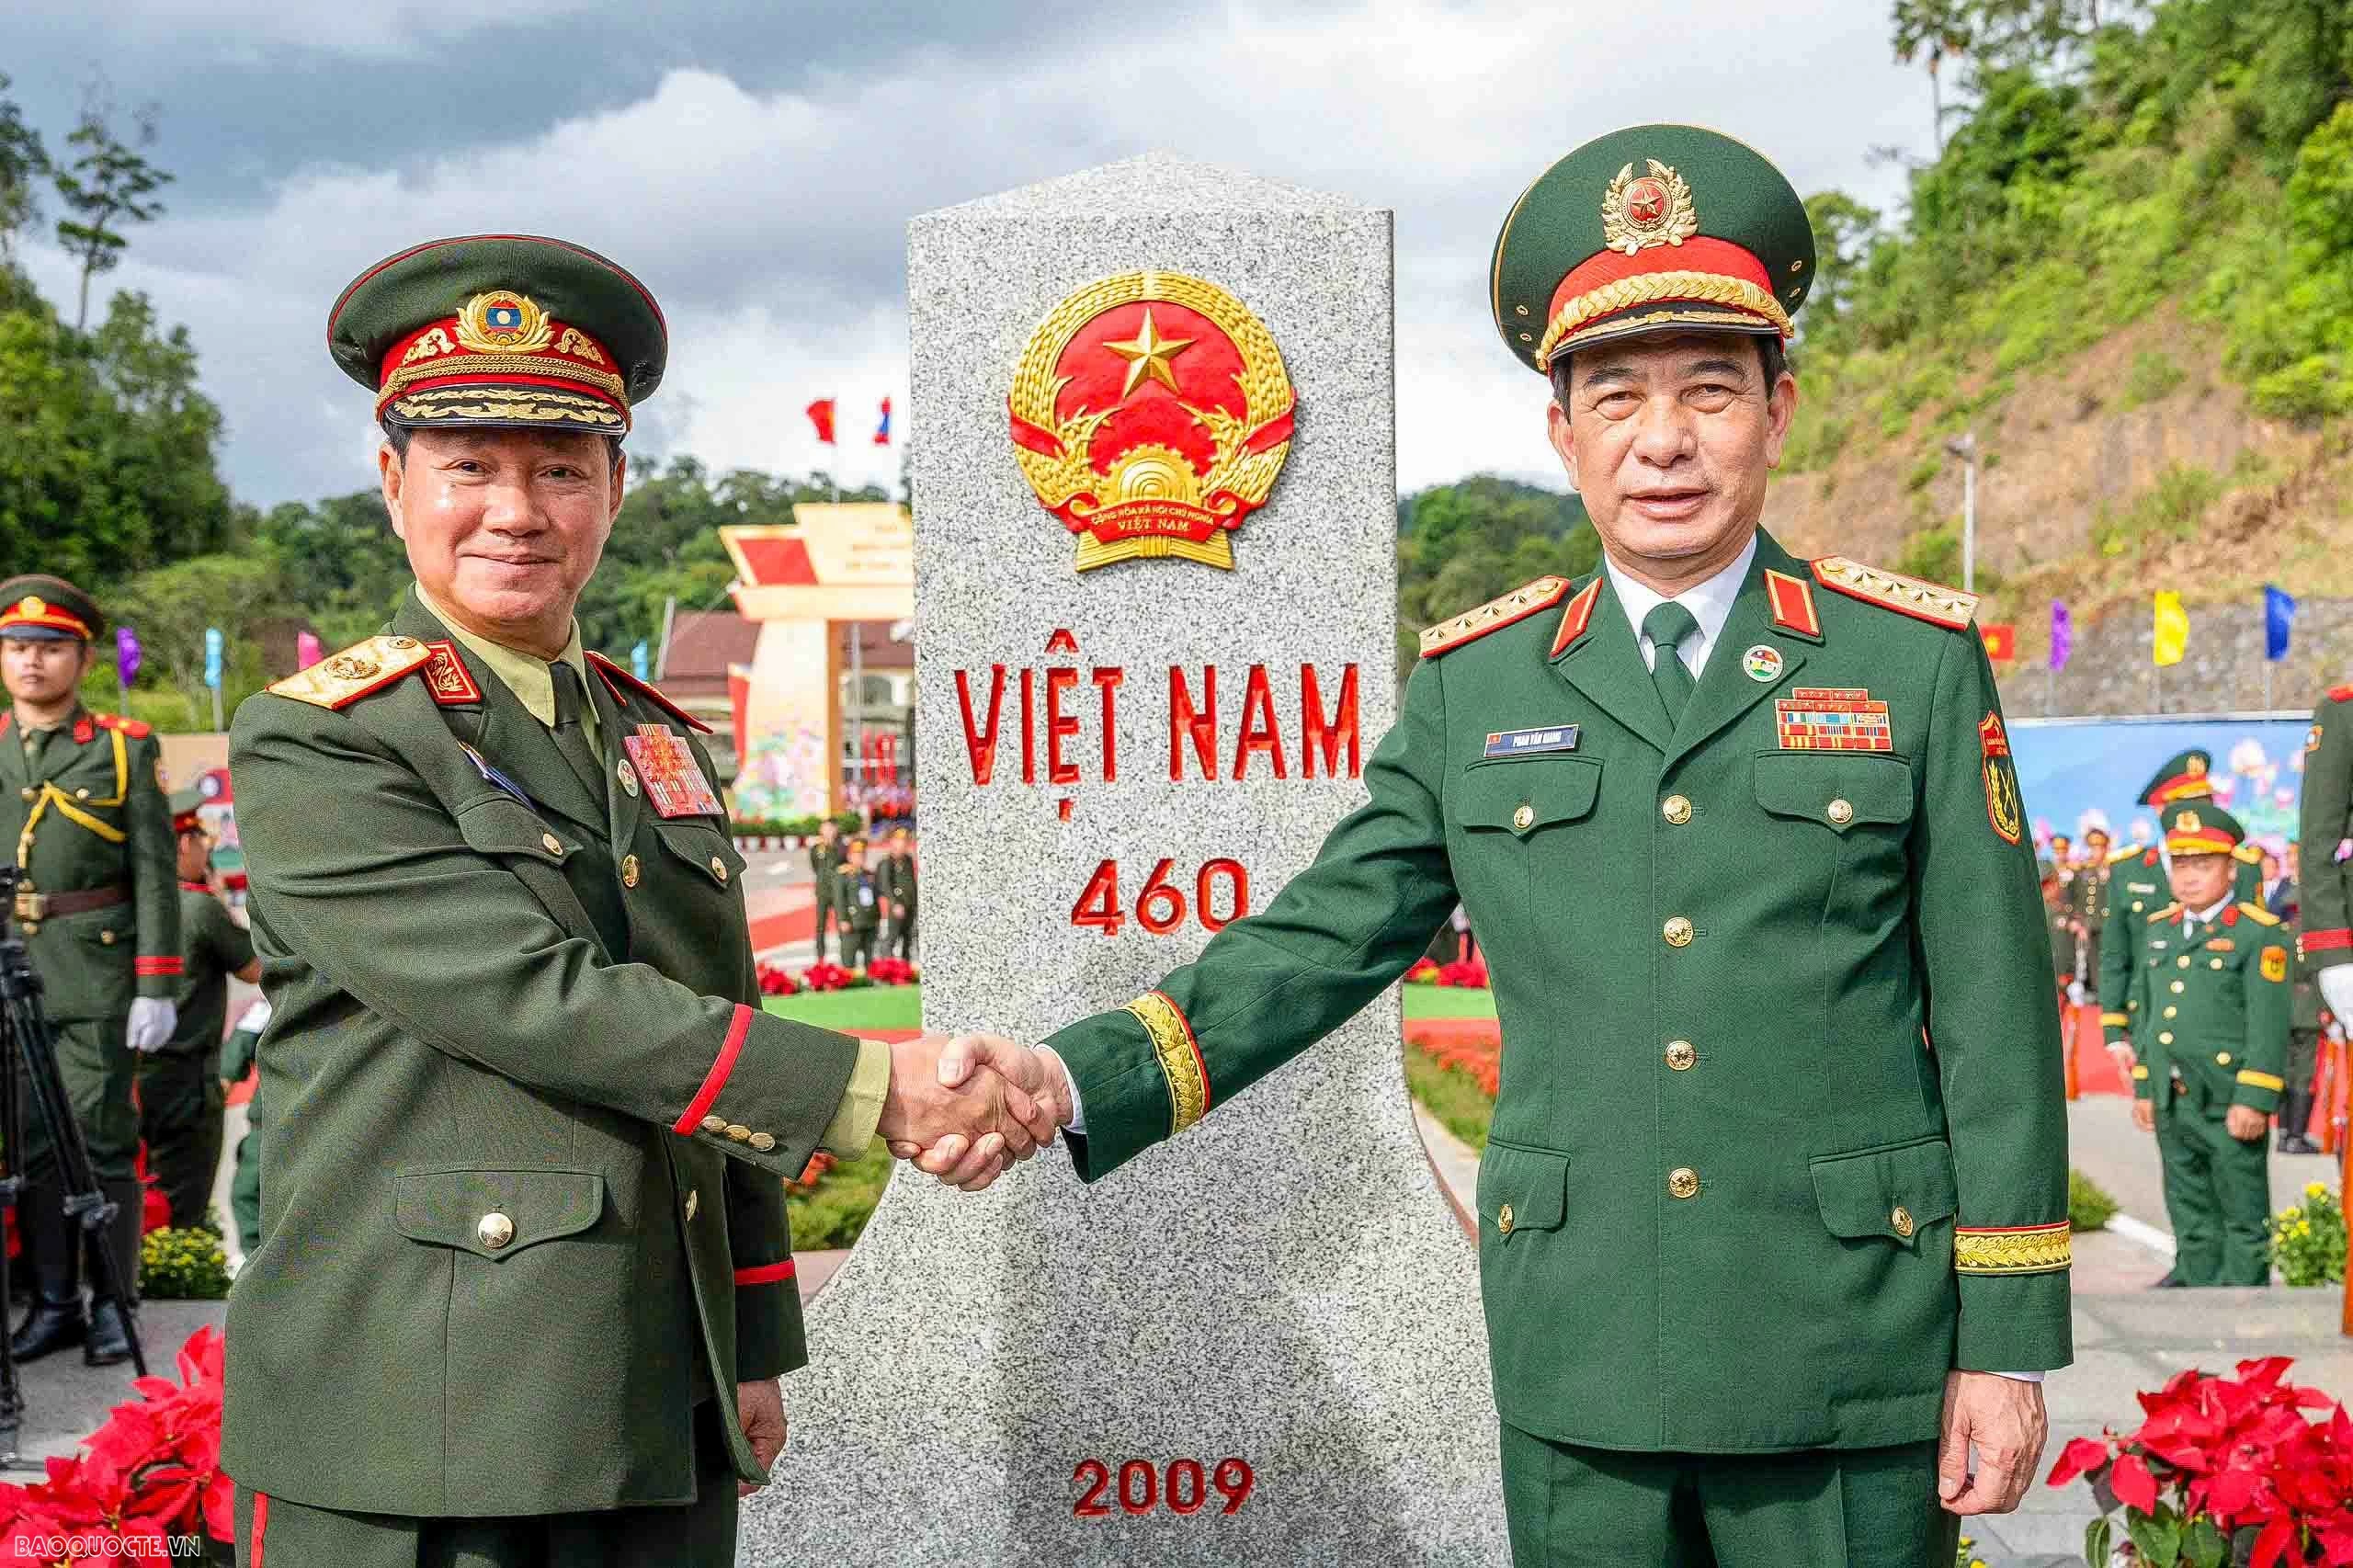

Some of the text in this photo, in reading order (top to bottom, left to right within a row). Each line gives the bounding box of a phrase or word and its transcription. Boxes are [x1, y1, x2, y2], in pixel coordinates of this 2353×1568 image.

[1117, 516, 1192, 532] VIỆT NAM
[954, 629, 1360, 823] VIỆT NAM
[1071, 858, 1251, 937] 460
[1073, 1457, 1255, 1517] 2009
